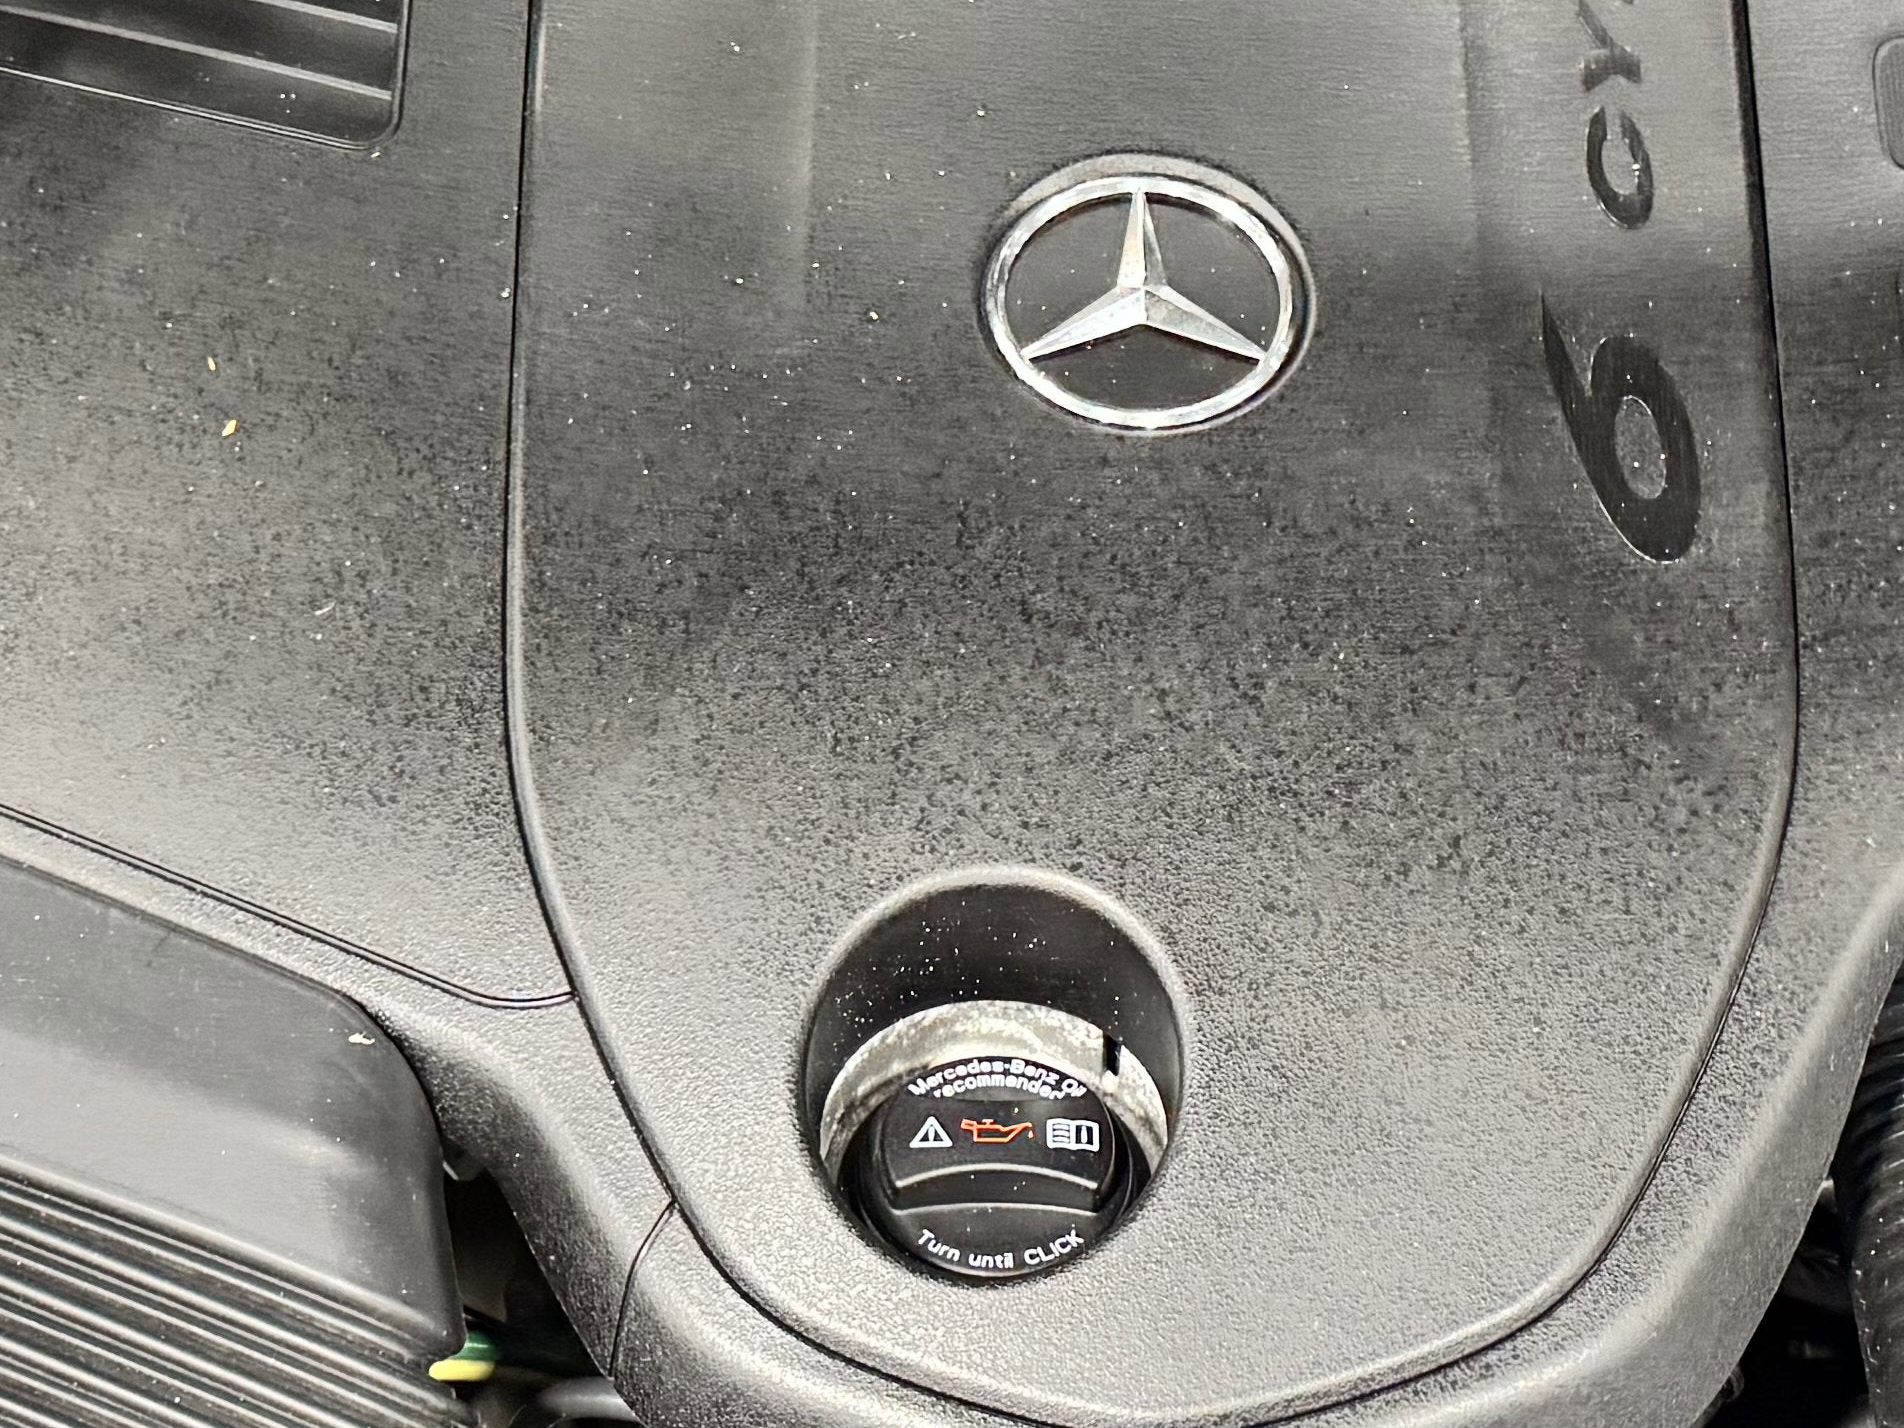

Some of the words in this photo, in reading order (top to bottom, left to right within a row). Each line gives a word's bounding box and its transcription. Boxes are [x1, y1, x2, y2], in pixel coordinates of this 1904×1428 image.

[1540, 286, 1699, 565] 6
[907, 1058, 1060, 1097] Mercedes-Benz
[1061, 1078, 1088, 1099] Oil
[917, 1228, 961, 1262] Turn
[968, 1251, 1015, 1269] until
[1023, 1229, 1085, 1265] CLICK
